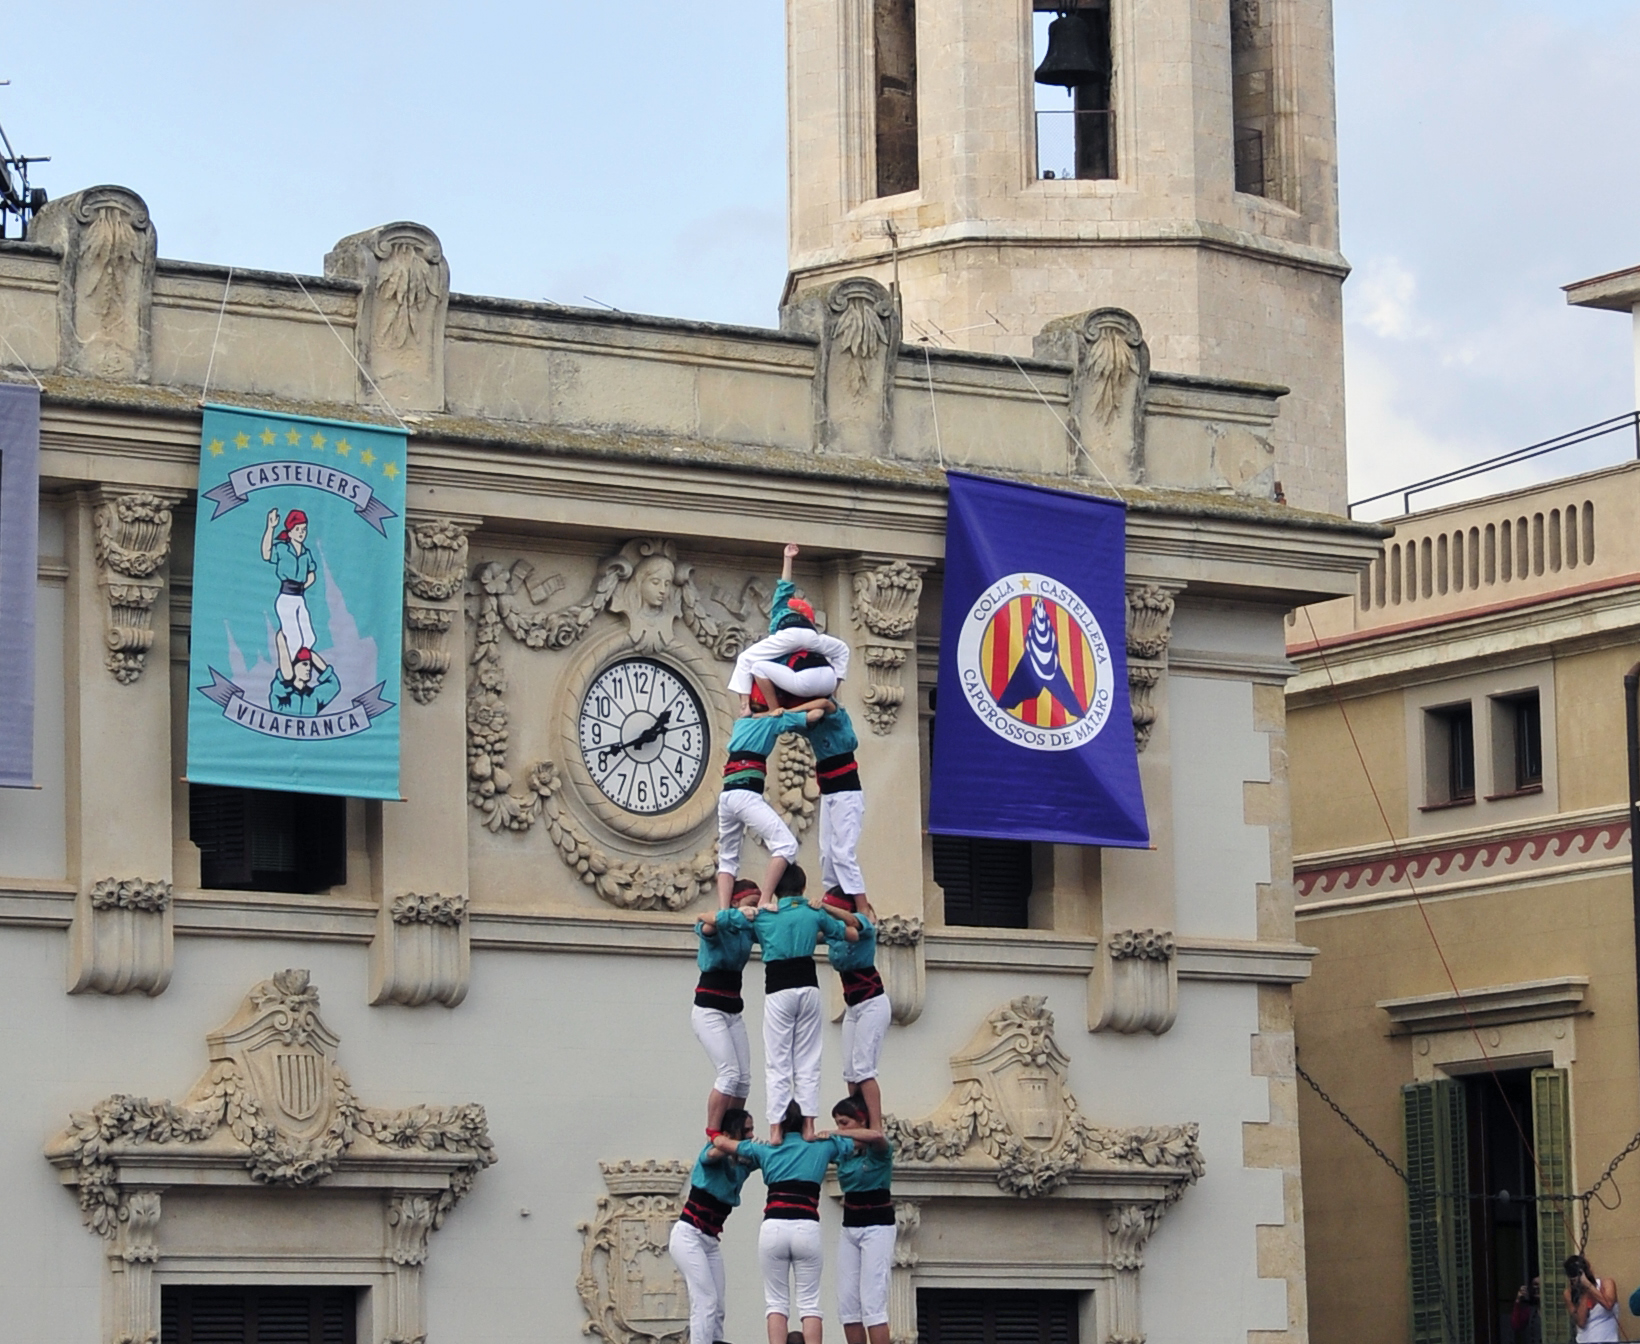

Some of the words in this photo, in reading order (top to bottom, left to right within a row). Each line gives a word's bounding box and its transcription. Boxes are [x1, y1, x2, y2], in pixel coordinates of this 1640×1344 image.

[246, 464, 362, 500] CASTELLERS
[973, 581, 1015, 622] COLLA
[1040, 580, 1108, 665] CASTELLERA
[611, 677, 624, 700] 11
[633, 671, 649, 694] 12
[660, 681, 666, 703] 1
[595, 696, 611, 718] 10
[675, 701, 685, 723] 2
[963, 668, 1046, 746] CAPGROSSOS
[1050, 730, 1074, 747] DE
[1075, 688, 1109, 741] MATARÓ
[236, 703, 361, 737] VILAFRANCA
[591, 723, 602, 745] 9
[682, 730, 692, 752] 3
[598, 751, 608, 773] 8
[674, 756, 684, 778] 4
[617, 773, 627, 796] 7
[637, 780, 648, 803] 6
[659, 776, 670, 799] 5
